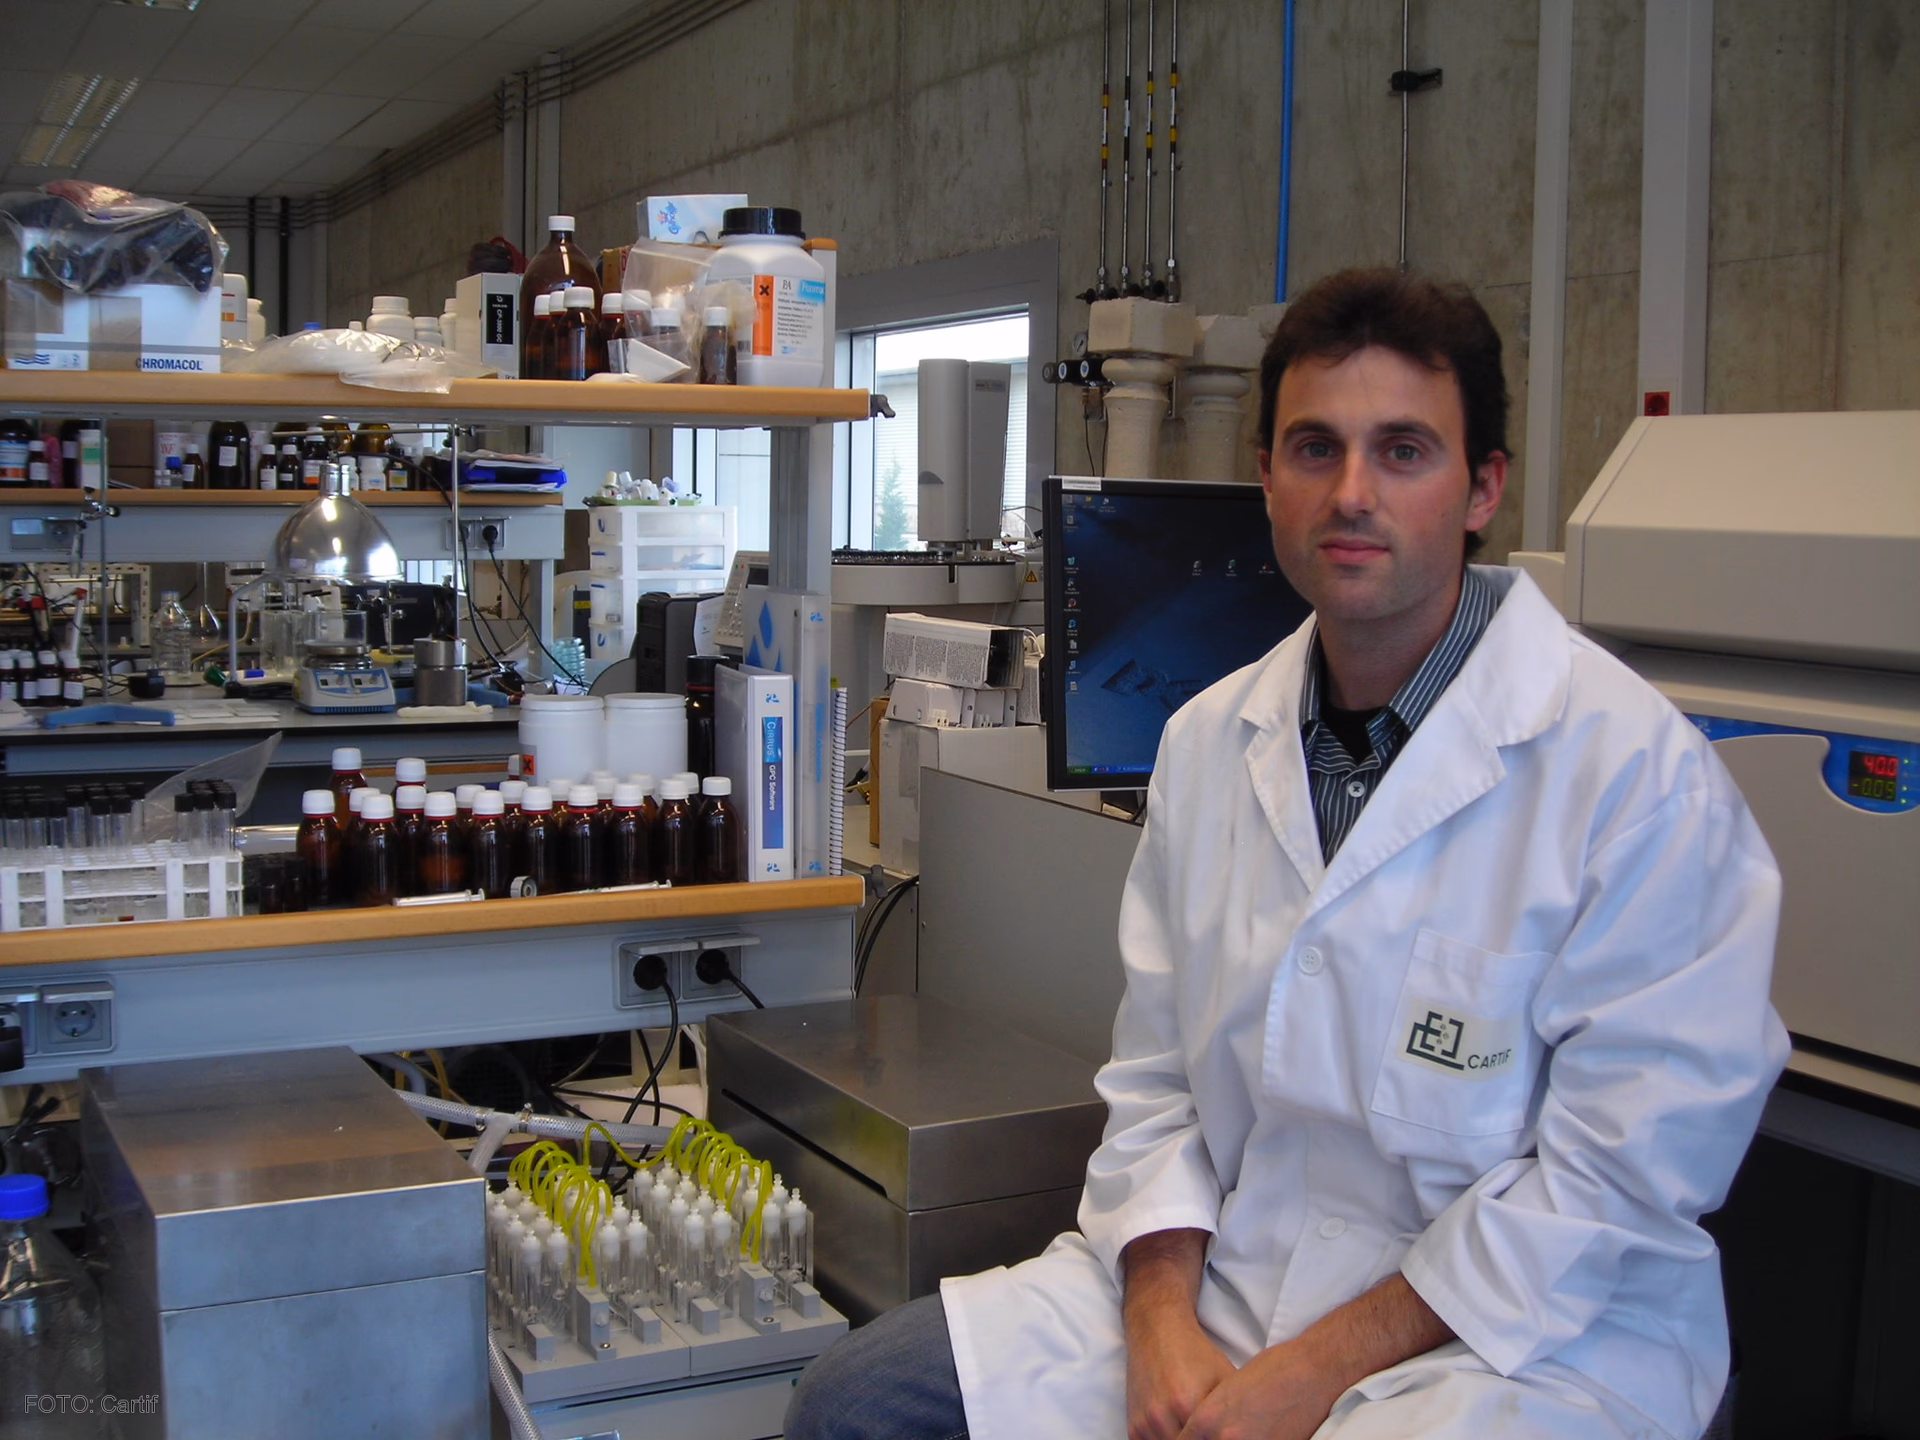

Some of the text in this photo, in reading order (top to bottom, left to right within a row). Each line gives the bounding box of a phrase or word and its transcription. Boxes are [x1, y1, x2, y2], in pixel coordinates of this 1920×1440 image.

[135, 357, 202, 371] CHROMACOL
[768, 764, 776, 781] GPC
[1467, 1049, 1512, 1069] CARTIF
